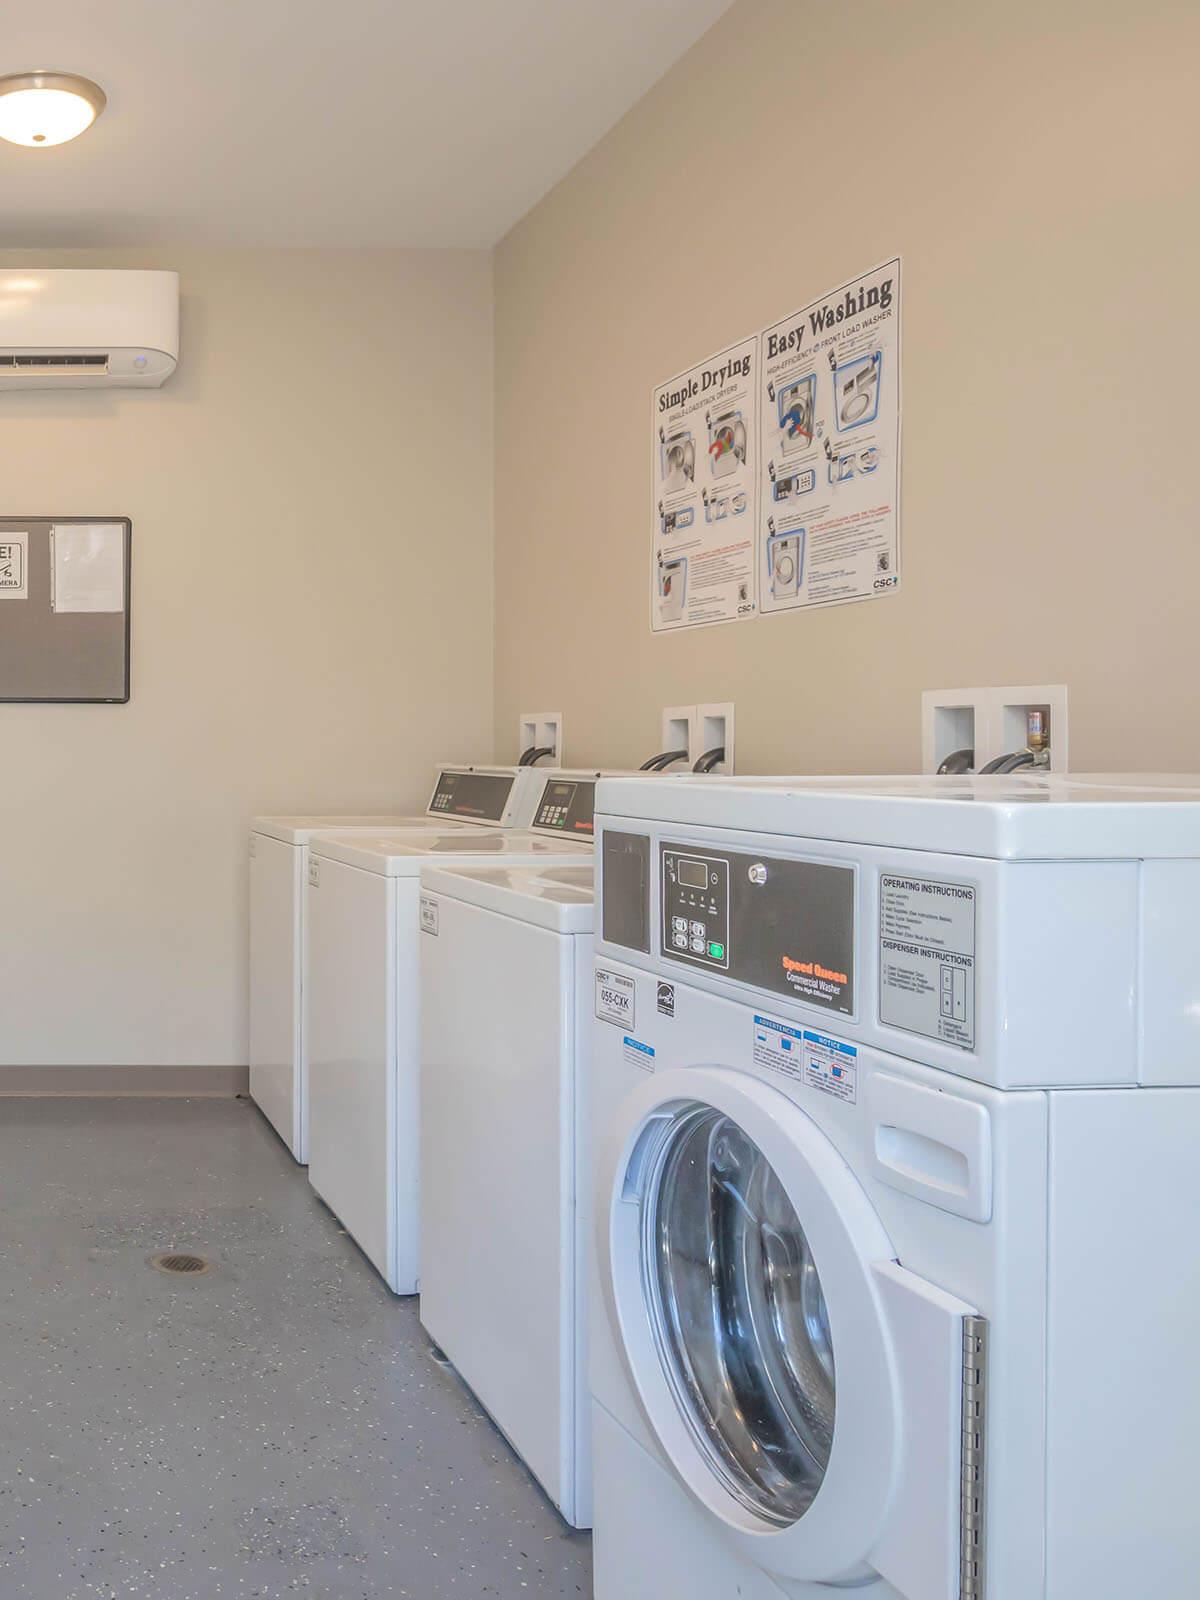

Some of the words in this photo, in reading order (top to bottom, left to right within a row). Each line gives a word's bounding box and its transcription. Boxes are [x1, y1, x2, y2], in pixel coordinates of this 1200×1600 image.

[767, 324, 805, 360] Easy
[808, 279, 893, 336] Washing
[821, 333, 841, 348] FRONT
[842, 324, 861, 338] LOAD
[861, 308, 892, 329] WASHER
[659, 379, 698, 412] Simple
[701, 354, 751, 391] Drying
[873, 578, 892, 588] CSC
[883, 878, 920, 892] OPERATING
[921, 883, 973, 900] INSTRUCTIONS
[882, 940, 919, 955] DISPENSER
[920, 949, 972, 967] INSTRUCTIONS
[783, 955, 813, 975] Speed
[814, 964, 848, 985] Queen
[786, 971, 818, 989] Commercial
[819, 979, 841, 995] Washer
[804, 986, 813, 995] High
[759, 1018, 796, 1036] ADVERTENCIA
[818, 1037, 841, 1050] NOTICE
